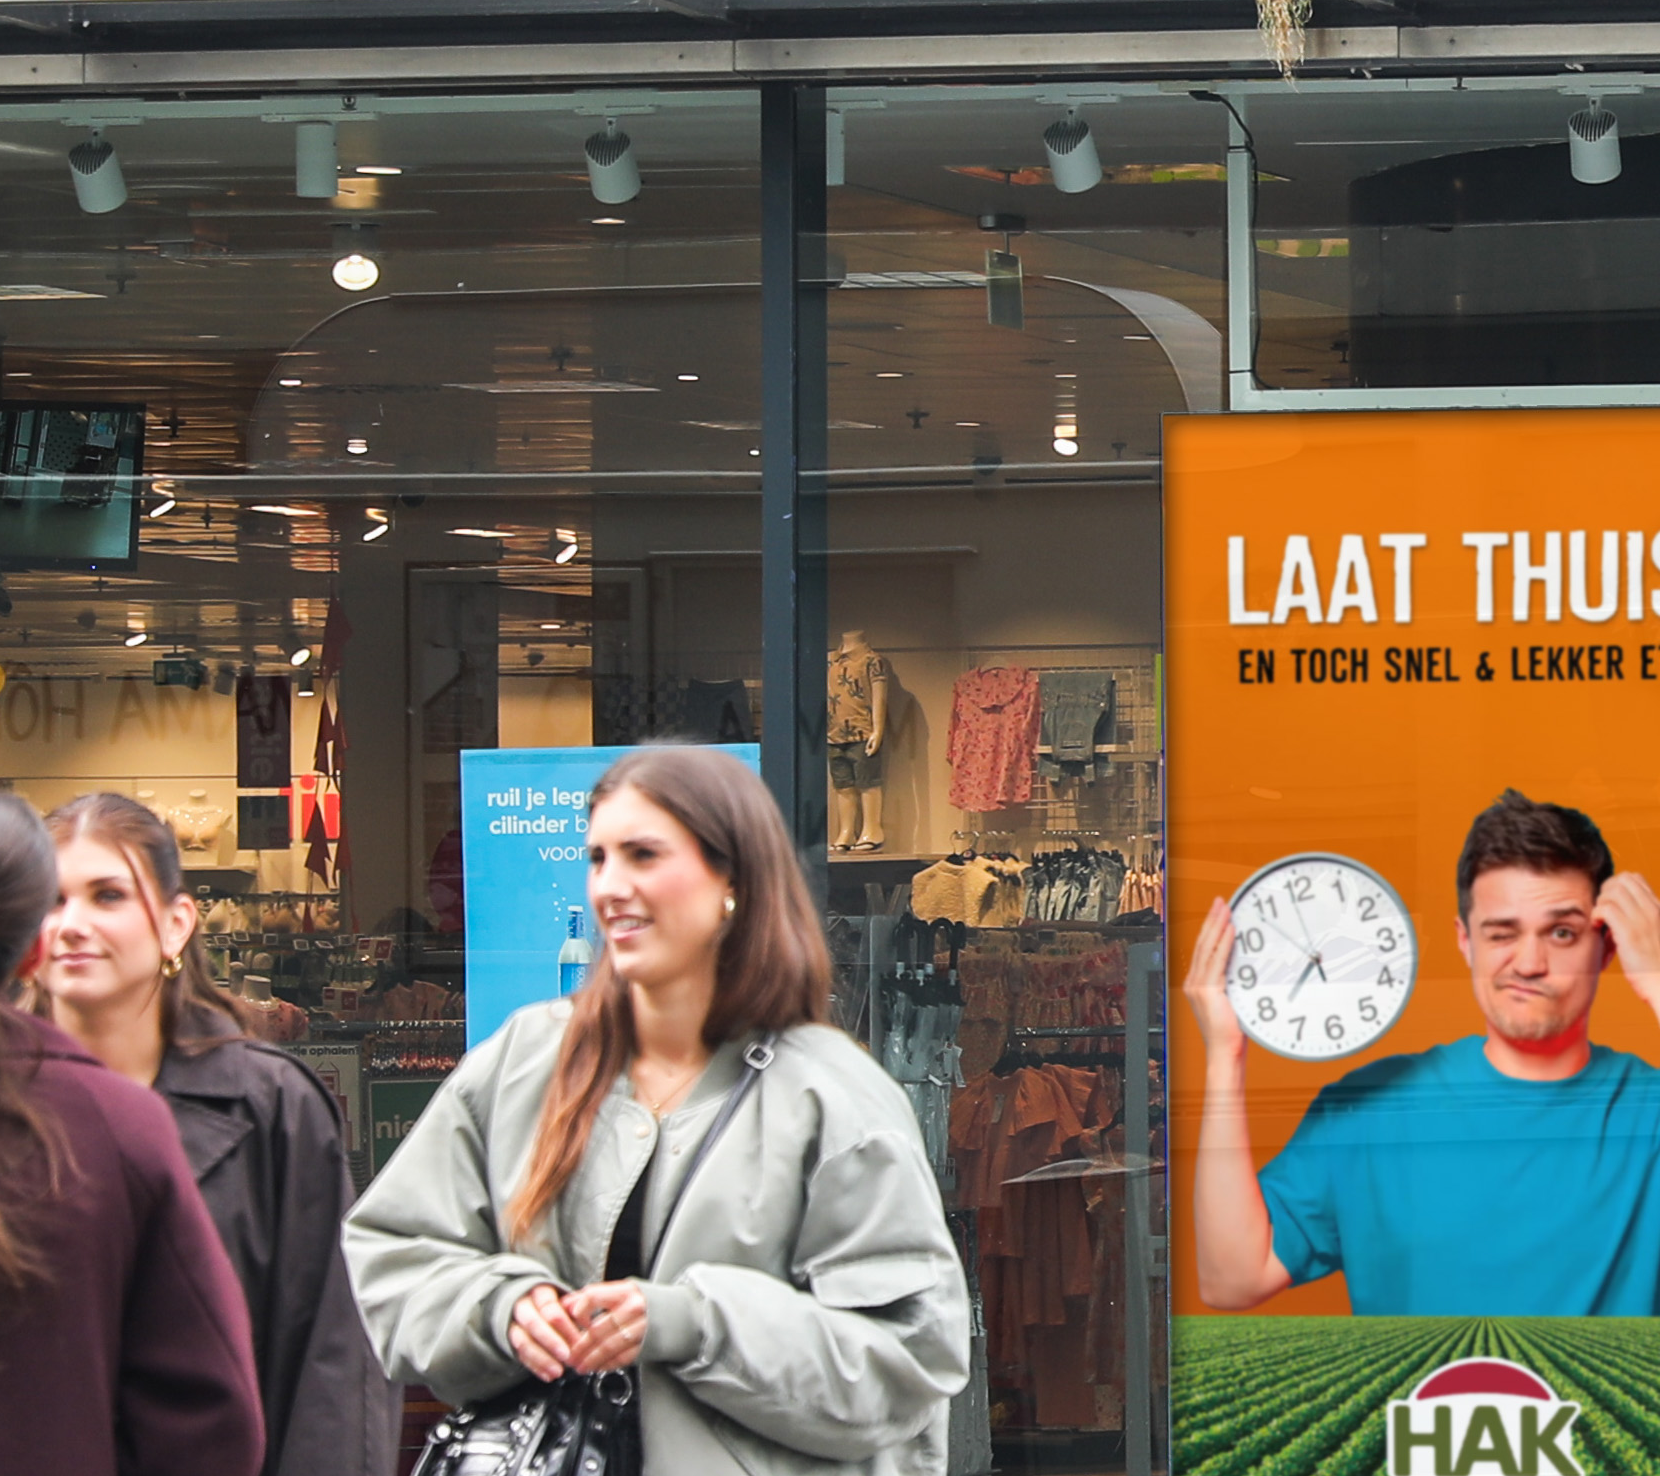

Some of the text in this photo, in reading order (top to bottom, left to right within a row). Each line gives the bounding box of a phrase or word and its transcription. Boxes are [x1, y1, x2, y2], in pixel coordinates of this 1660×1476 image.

[1226, 532, 1428, 627] LAAT
[1238, 652, 1275, 684] EN
[1292, 649, 1369, 684] TOCH
[1385, 648, 1455, 683] SNEL
[1475, 651, 1496, 682] &
[1511, 645, 1625, 681] LEKKER
[487, 788, 521, 808] ruil
[525, 787, 547, 812] je
[489, 815, 569, 835] cilinder
[1283, 875, 1315, 903] 12
[1330, 878, 1346, 904] 1
[1252, 894, 1279, 920] 11
[1357, 895, 1379, 923] 2
[1234, 926, 1266, 955] 10
[1375, 926, 1398, 953] 3
[1237, 964, 1258, 991] 9
[1376, 964, 1396, 990] 4
[1256, 996, 1278, 1023] 8
[1358, 995, 1378, 1023] 5
[1287, 1015, 1307, 1043] 7
[1324, 1013, 1346, 1041] 6
